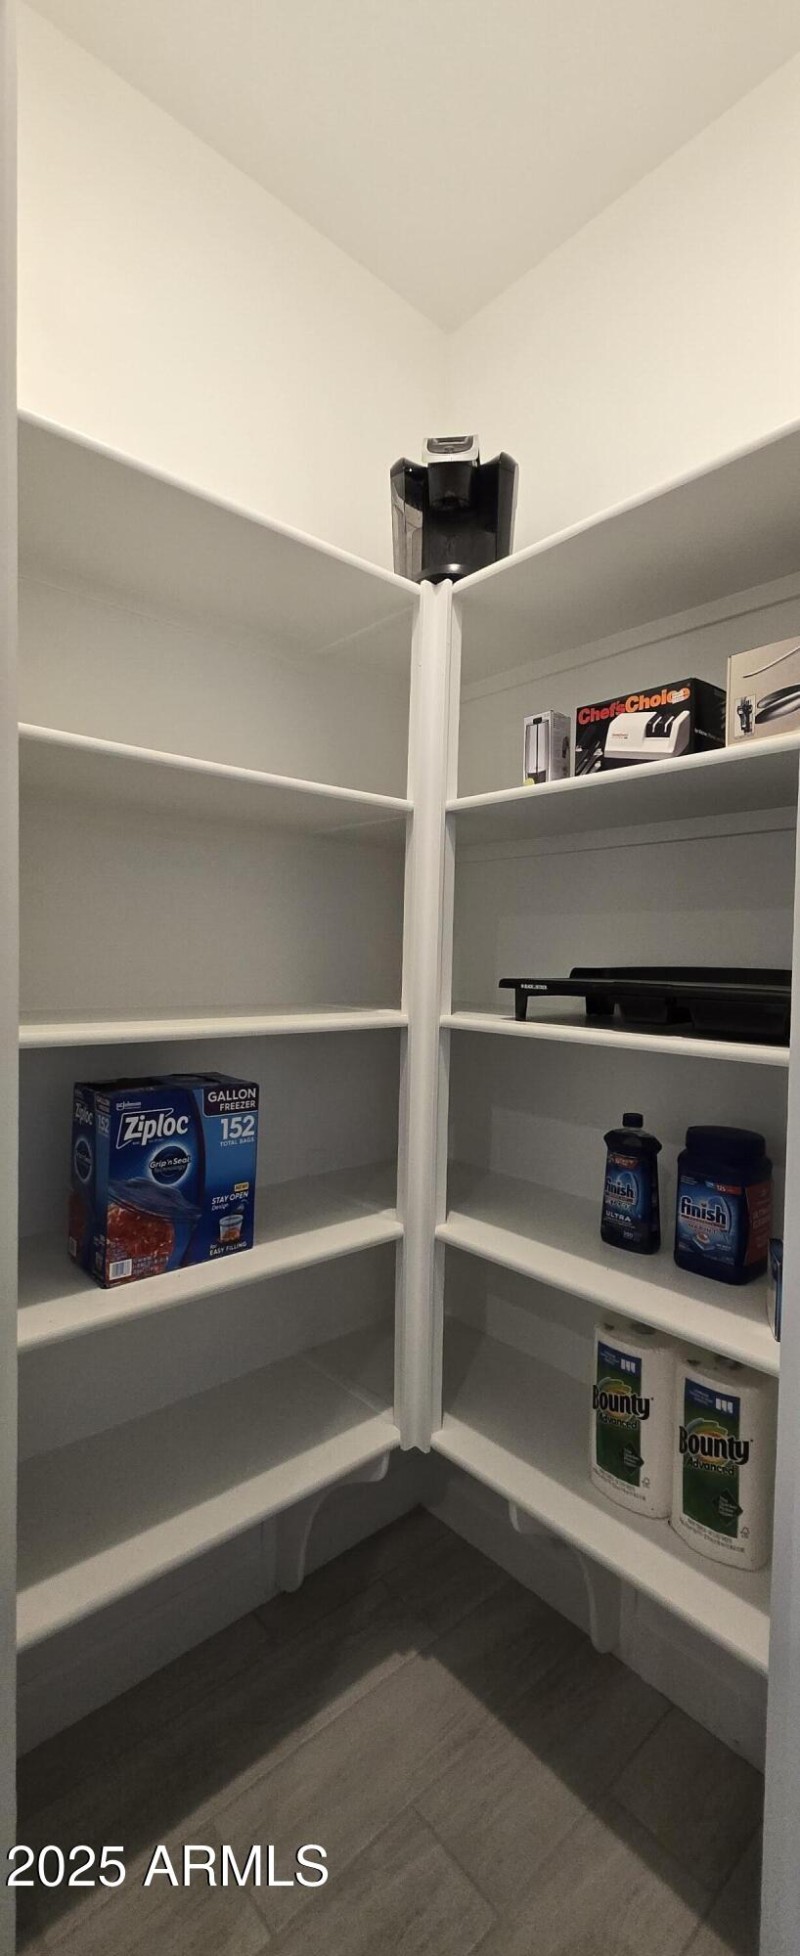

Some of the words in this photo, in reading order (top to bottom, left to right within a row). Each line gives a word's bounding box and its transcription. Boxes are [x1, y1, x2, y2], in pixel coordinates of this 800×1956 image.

[207, 1088, 257, 1103] GALLON
[219, 1100, 256, 1112] FREEZER
[123, 1113, 189, 1146] Ziploc
[220, 1115, 255, 1140] 152
[220, 1139, 238, 1147] TOTAL
[239, 1137, 255, 1145] BAGS
[605, 1177, 634, 1198] finish
[211, 1194, 230, 1205] STAY
[230, 1190, 249, 1201] OPEN
[605, 1210, 632, 1223] ULTRA
[681, 1196, 726, 1225] finish
[209, 1246, 225, 1256] EASY
[592, 1384, 650, 1420] Bounty
[599, 1412, 638, 1430] Advanced
[679, 1425, 750, 1465] Bounty
[687, 1457, 735, 1476] Advanced
